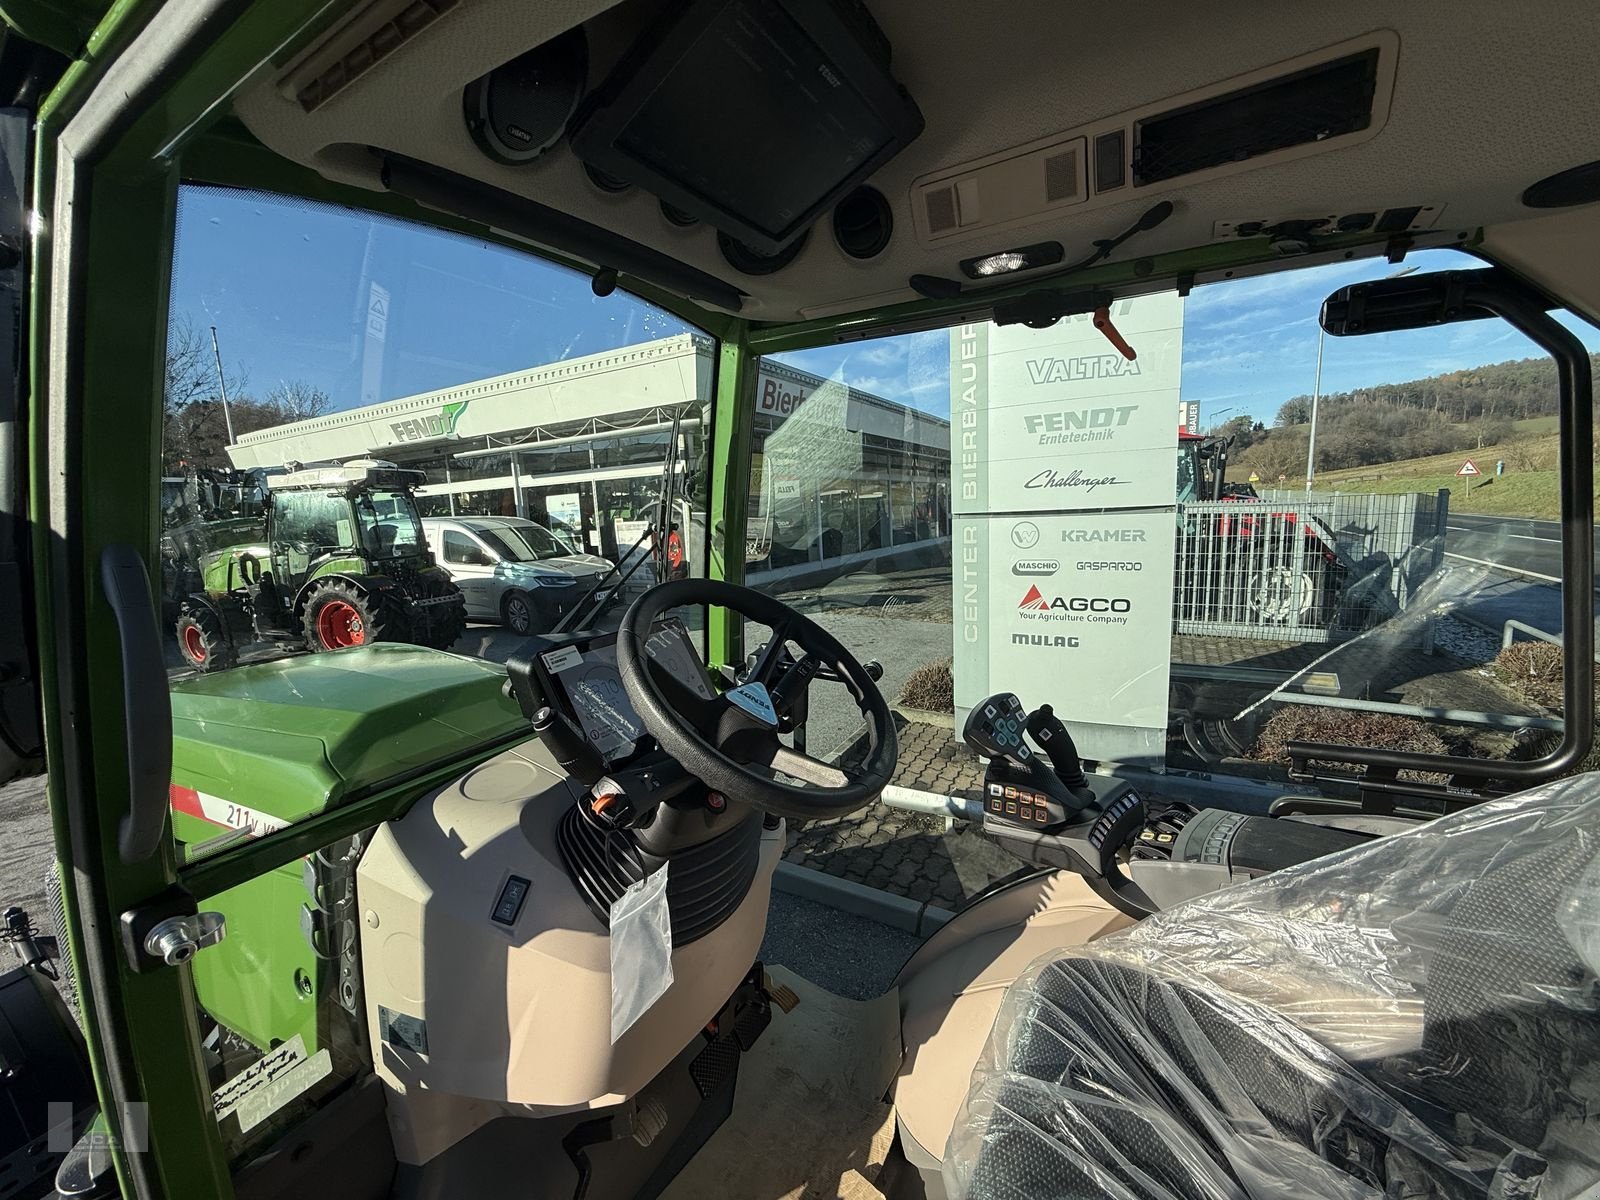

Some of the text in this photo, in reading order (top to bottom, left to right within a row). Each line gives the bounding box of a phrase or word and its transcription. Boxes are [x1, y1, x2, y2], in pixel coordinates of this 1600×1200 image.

[1026, 354, 1141, 385] VALTRA
[389, 412, 453, 443] FENDT
[1024, 405, 1139, 434] FENDT
[1038, 428, 1115, 446] Erntetechnik
[1024, 469, 1133, 493] Challenger
[1061, 529, 1147, 542] KRAMER
[1018, 562, 1058, 570] MASCHIO
[1076, 561, 1142, 571] GASPARDO
[963, 525, 978, 643] CENTER
[1050, 597, 1131, 613] AGCO
[1019, 611, 1128, 625] Your Agriculture Company
[1012, 633, 1080, 648] MULAG
